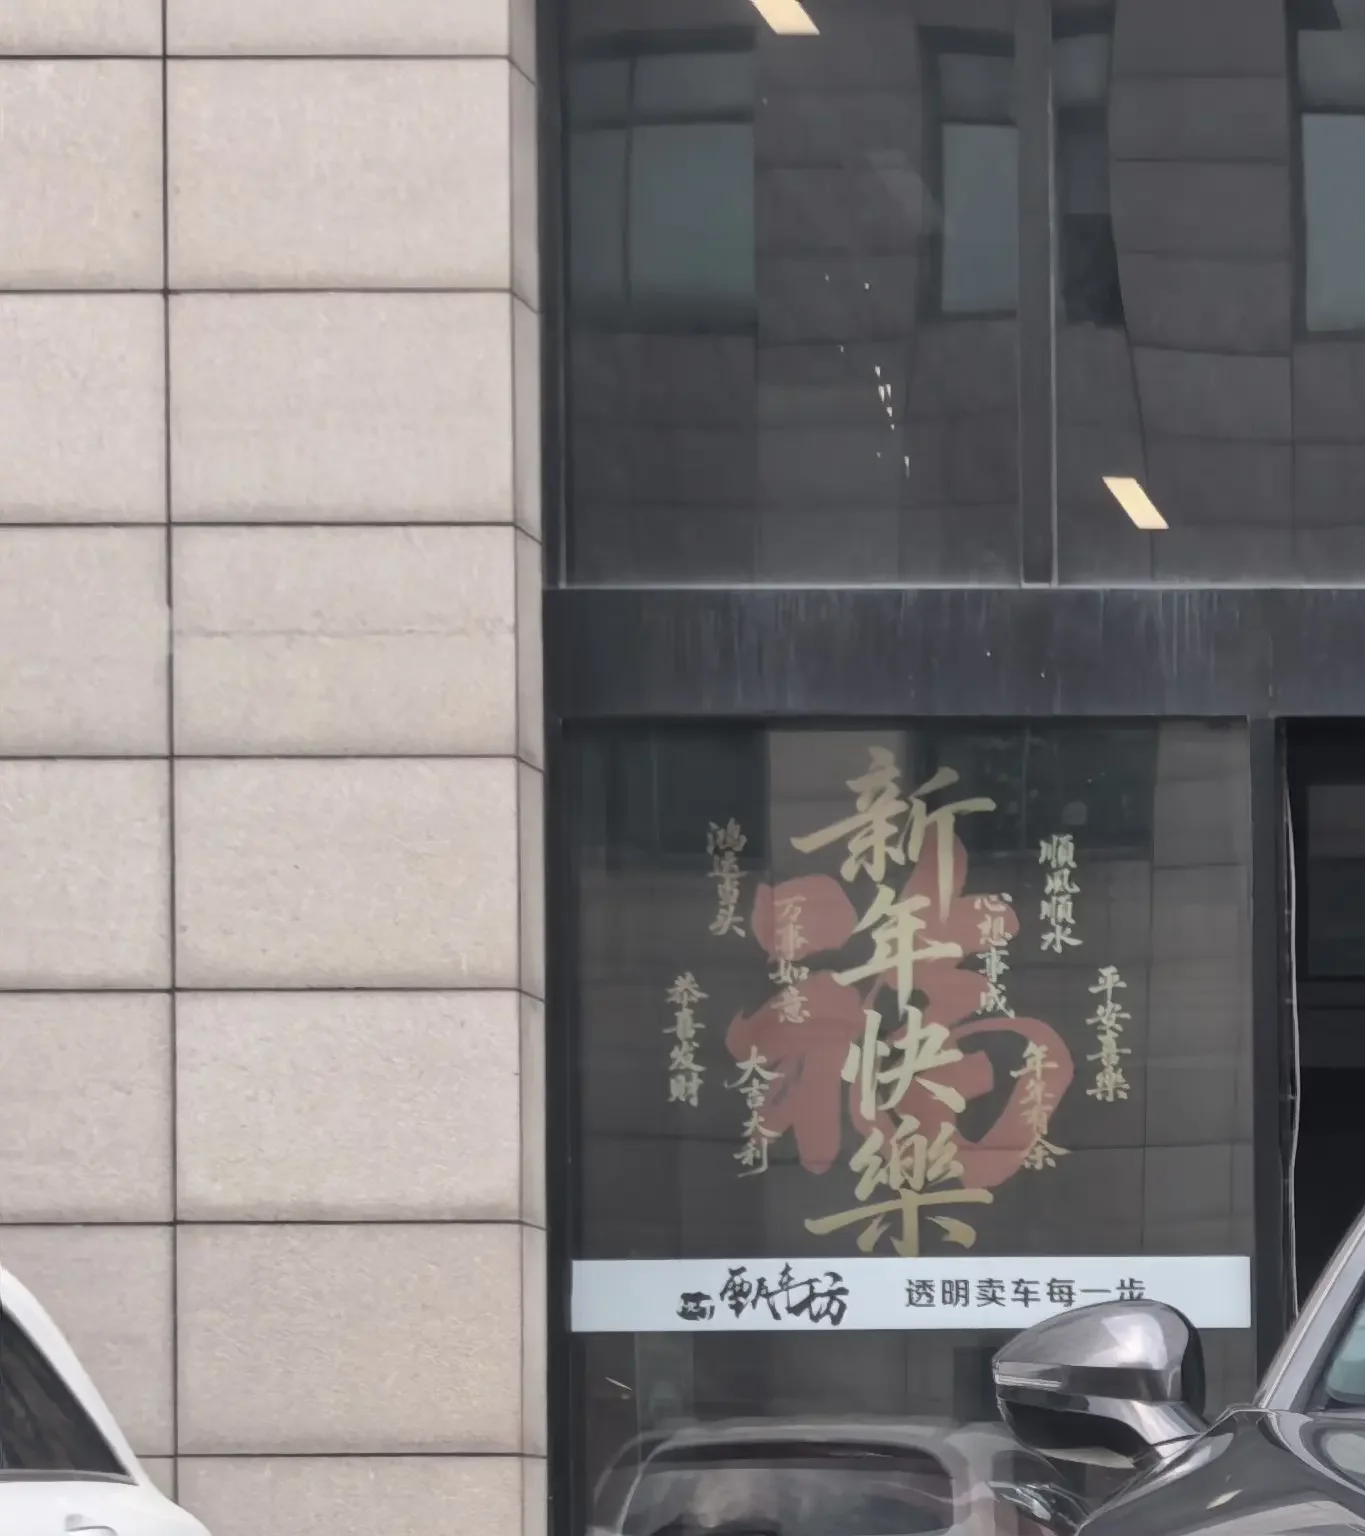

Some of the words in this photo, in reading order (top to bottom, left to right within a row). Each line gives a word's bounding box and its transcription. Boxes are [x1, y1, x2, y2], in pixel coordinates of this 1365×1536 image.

[768, 895, 811, 1024] 万事如意
[790, 746, 997, 1257] 新年快樂
[973, 892, 1016, 1020] 心想事成
[663, 971, 709, 1107] 恭喜发财
[723, 1045, 785, 1178] 大吉大利
[904, 1278, 1147, 1307] 透明卖车每一步
